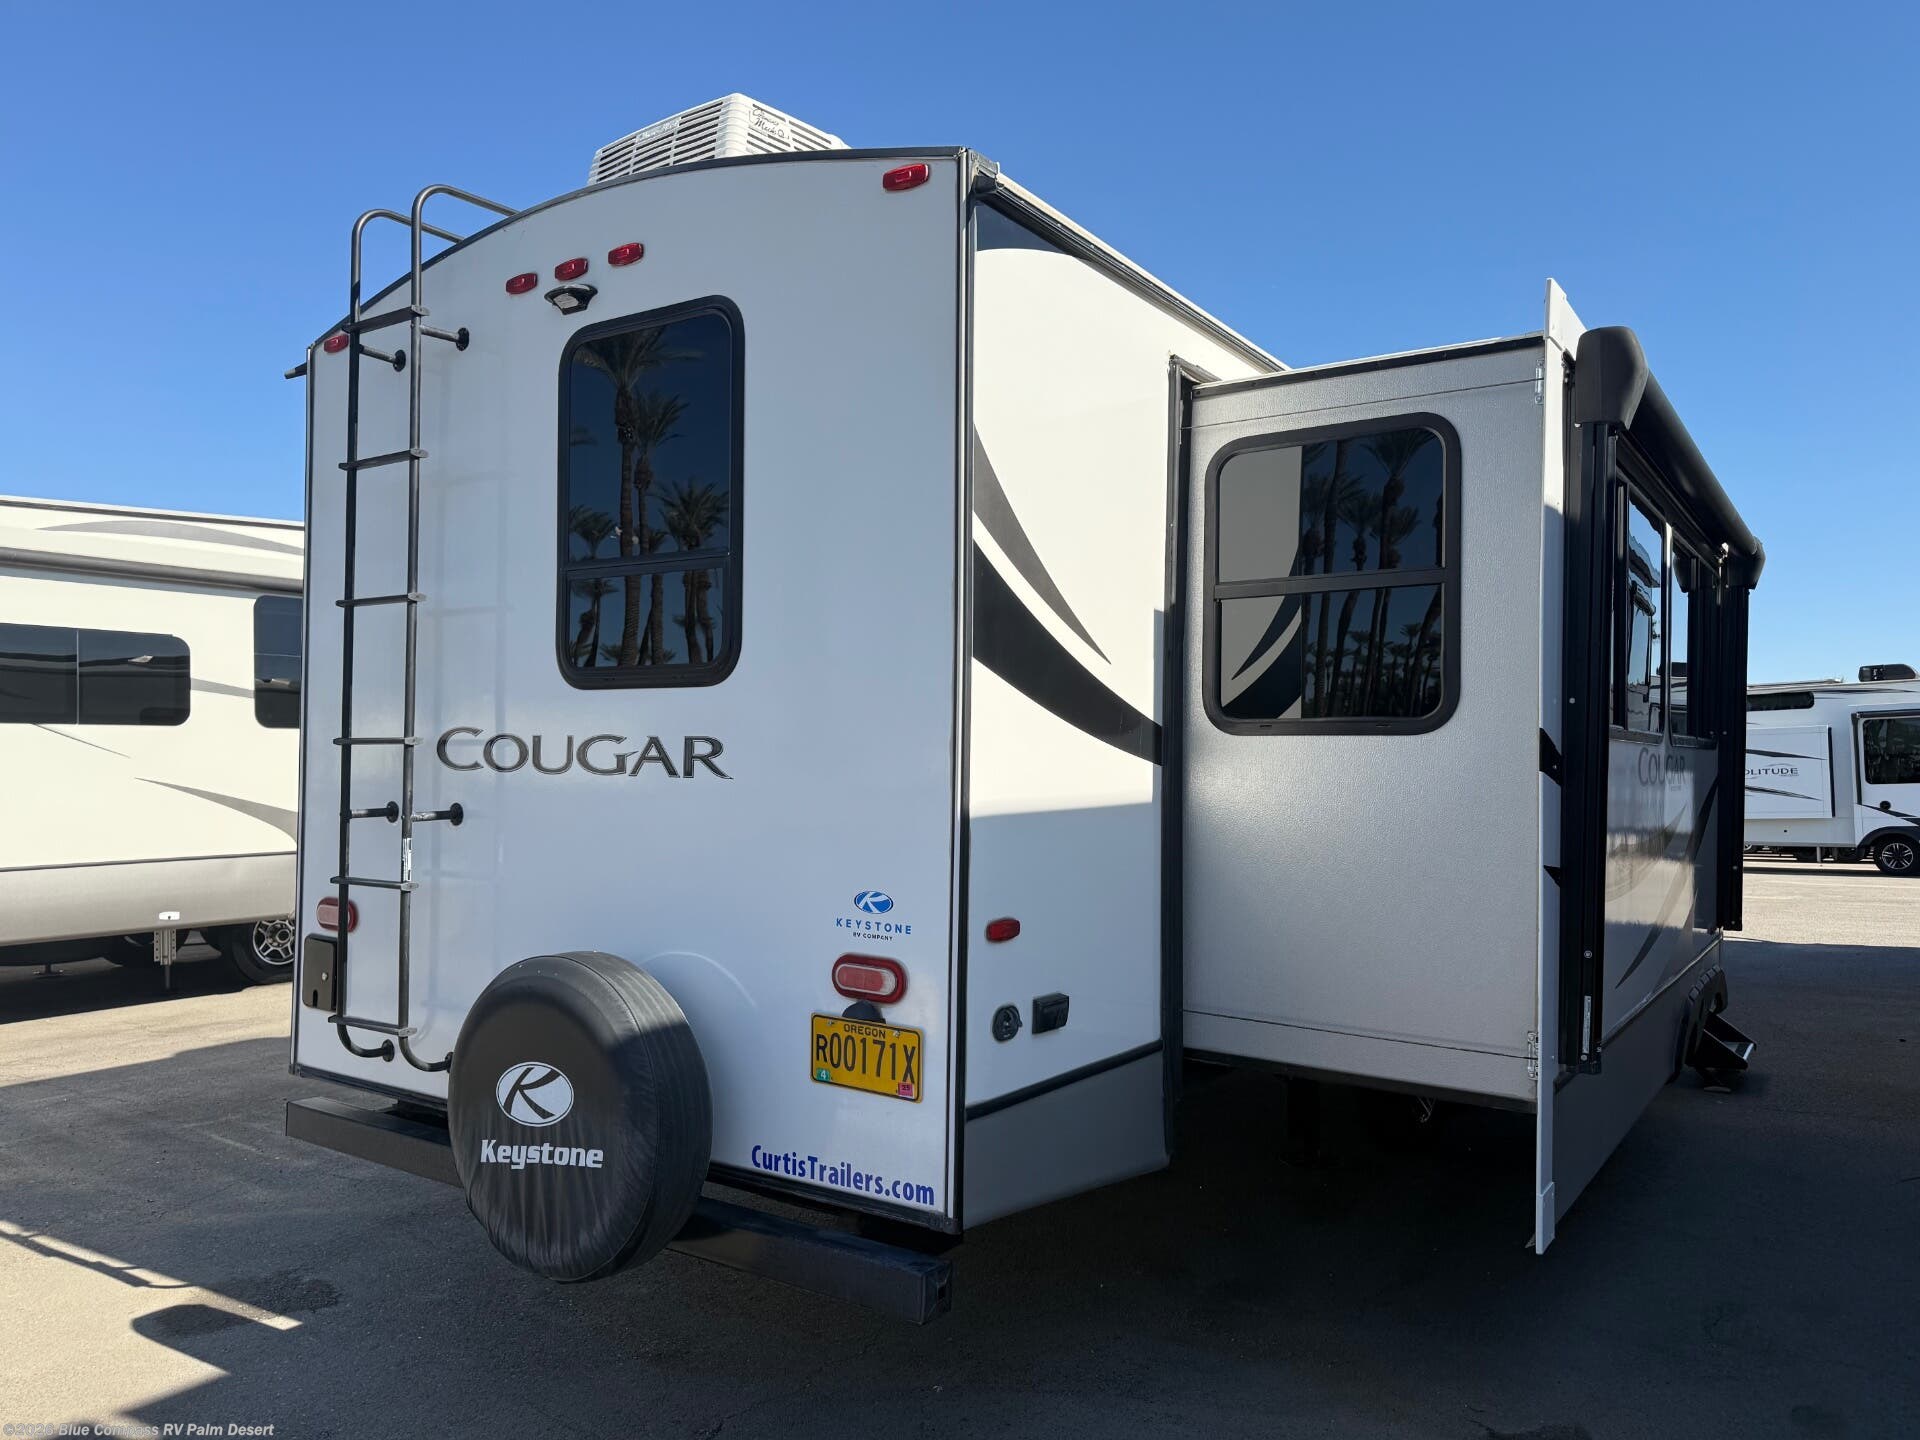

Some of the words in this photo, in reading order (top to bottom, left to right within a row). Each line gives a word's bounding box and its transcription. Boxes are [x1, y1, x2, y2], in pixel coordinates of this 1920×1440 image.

[1745, 767, 1799, 776] OLITUDE
[836, 917, 912, 935] KEYSTONE
[862, 933, 893, 941] COMPANY
[843, 1023, 886, 1039] OREGON
[816, 1033, 916, 1084] R00171X
[820, 1069, 827, 1080] 4
[480, 1139, 604, 1170] Keystone
[751, 1145, 936, 1206] CurtisTrailers.com
